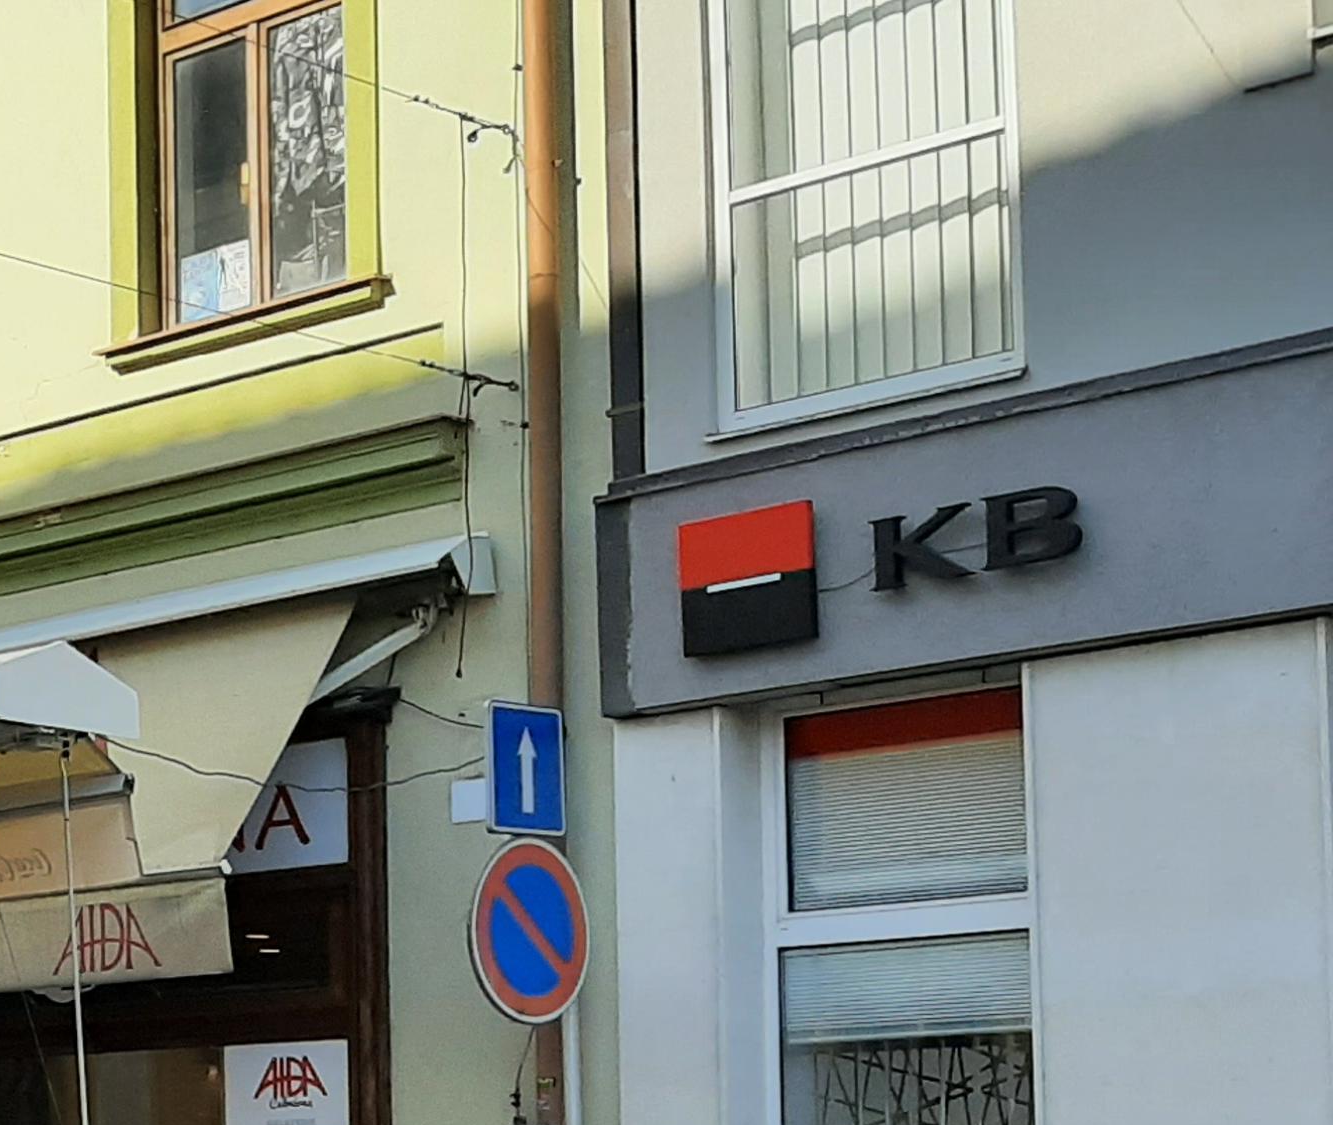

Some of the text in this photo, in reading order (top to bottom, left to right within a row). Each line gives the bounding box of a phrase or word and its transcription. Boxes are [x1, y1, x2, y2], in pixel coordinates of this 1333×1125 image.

[868, 486, 1083, 592] KB
[53, 903, 162, 977] AIDA
[253, 1055, 329, 1100] AIDA
